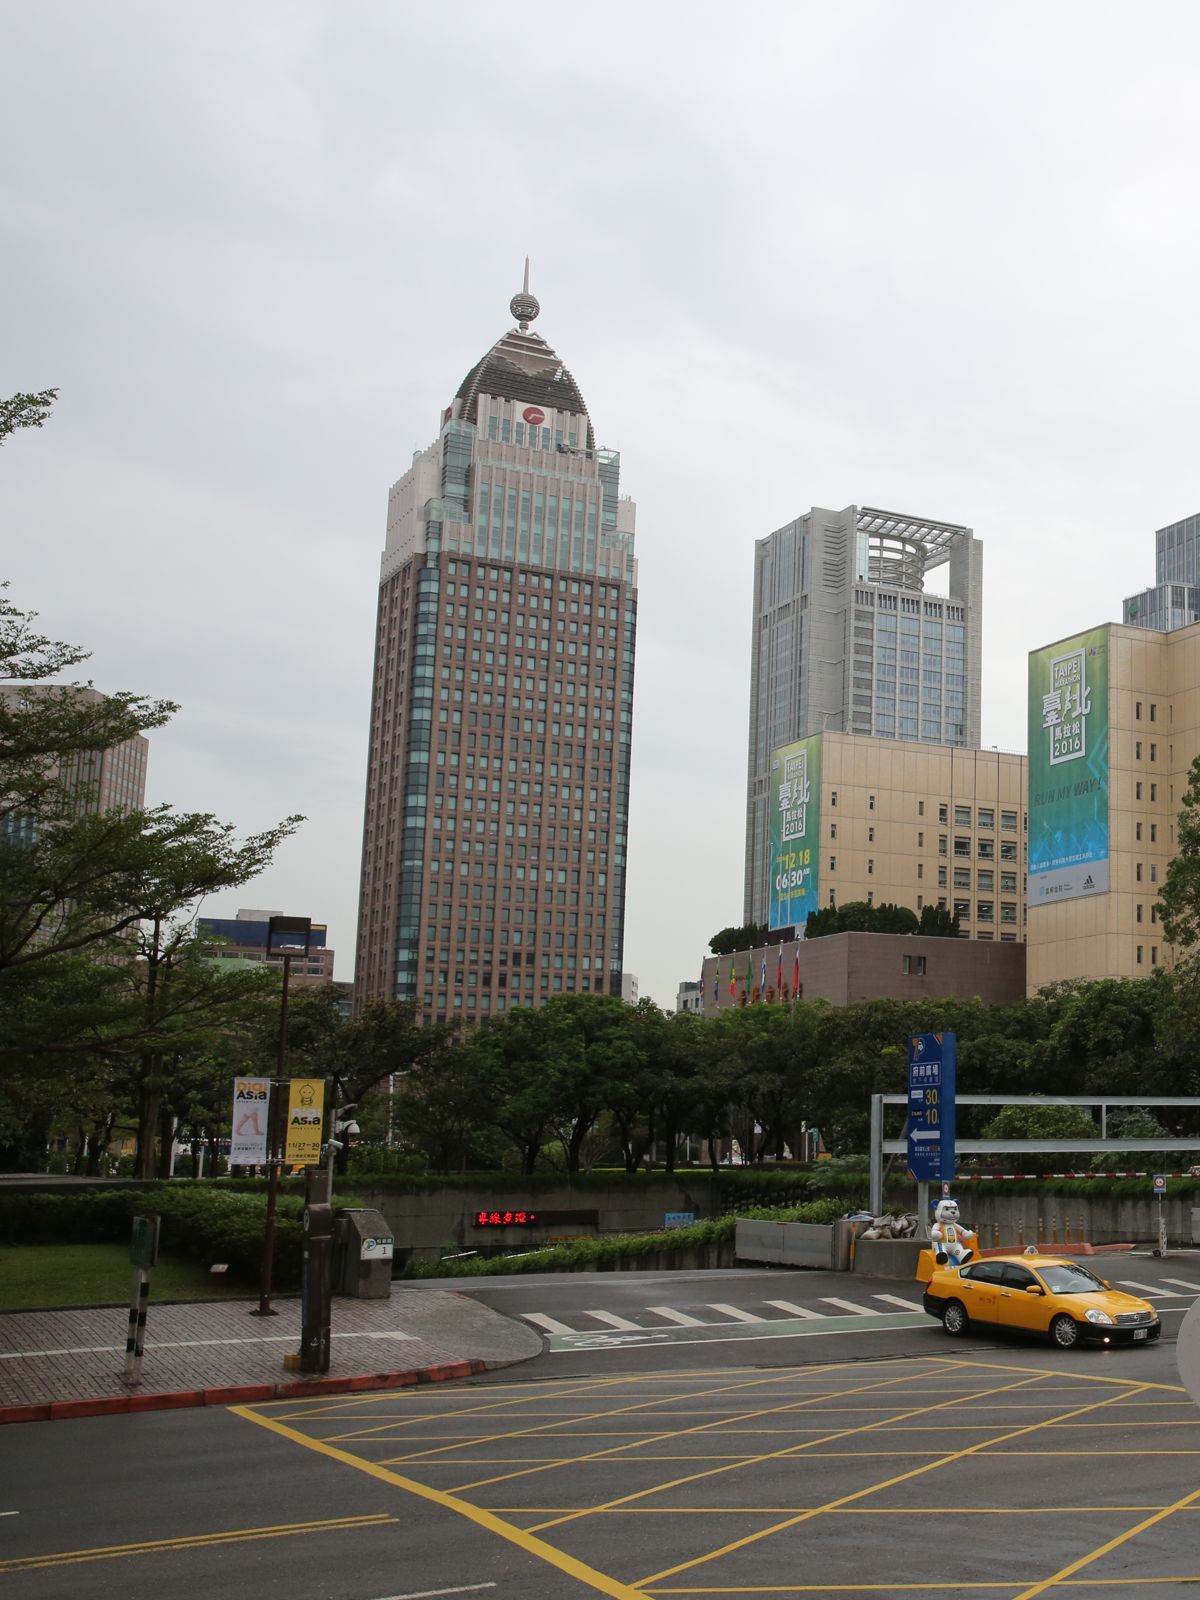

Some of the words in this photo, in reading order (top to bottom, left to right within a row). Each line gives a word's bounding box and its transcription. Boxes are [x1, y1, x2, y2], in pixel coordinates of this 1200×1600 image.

[1042, 683, 1091, 728] 臺北
[1055, 721, 1080, 741] 馬拉松
[1054, 737, 1081, 756] 2016
[779, 777, 810, 811] 臺北
[1057, 784, 1073, 801] MY
[785, 821, 803, 835] 2016
[912, 1064, 939, 1077] 府前廣場
[925, 1089, 938, 1105] 30
[925, 1108, 938, 1125] 10
